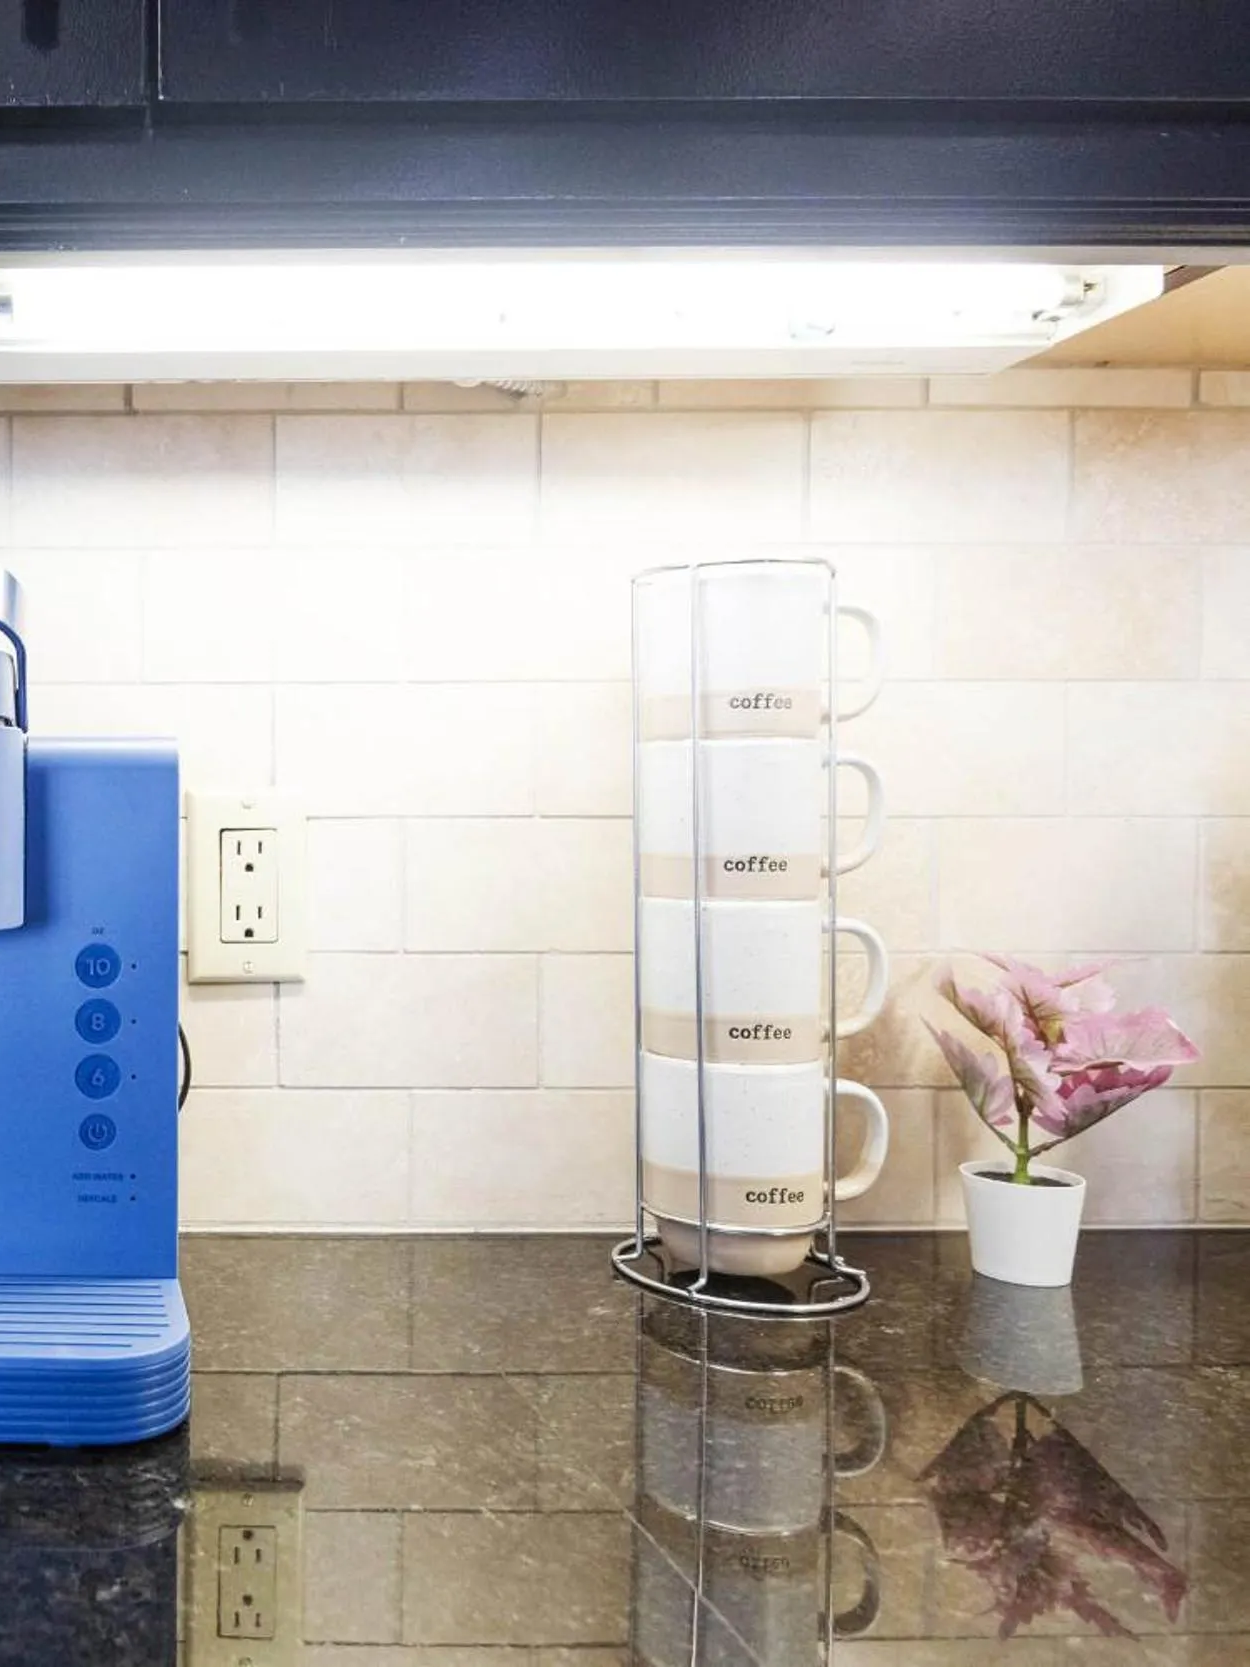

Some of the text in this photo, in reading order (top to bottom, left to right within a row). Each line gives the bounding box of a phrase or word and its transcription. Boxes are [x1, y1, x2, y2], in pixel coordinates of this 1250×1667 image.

[729, 693, 793, 710] coffee
[723, 857, 788, 873] coffee
[85, 957, 111, 977] 10
[91, 1012, 106, 1032] 8
[728, 1024, 792, 1041] coffee
[91, 1067, 106, 1087] 6
[745, 1188, 805, 1204] coffee
